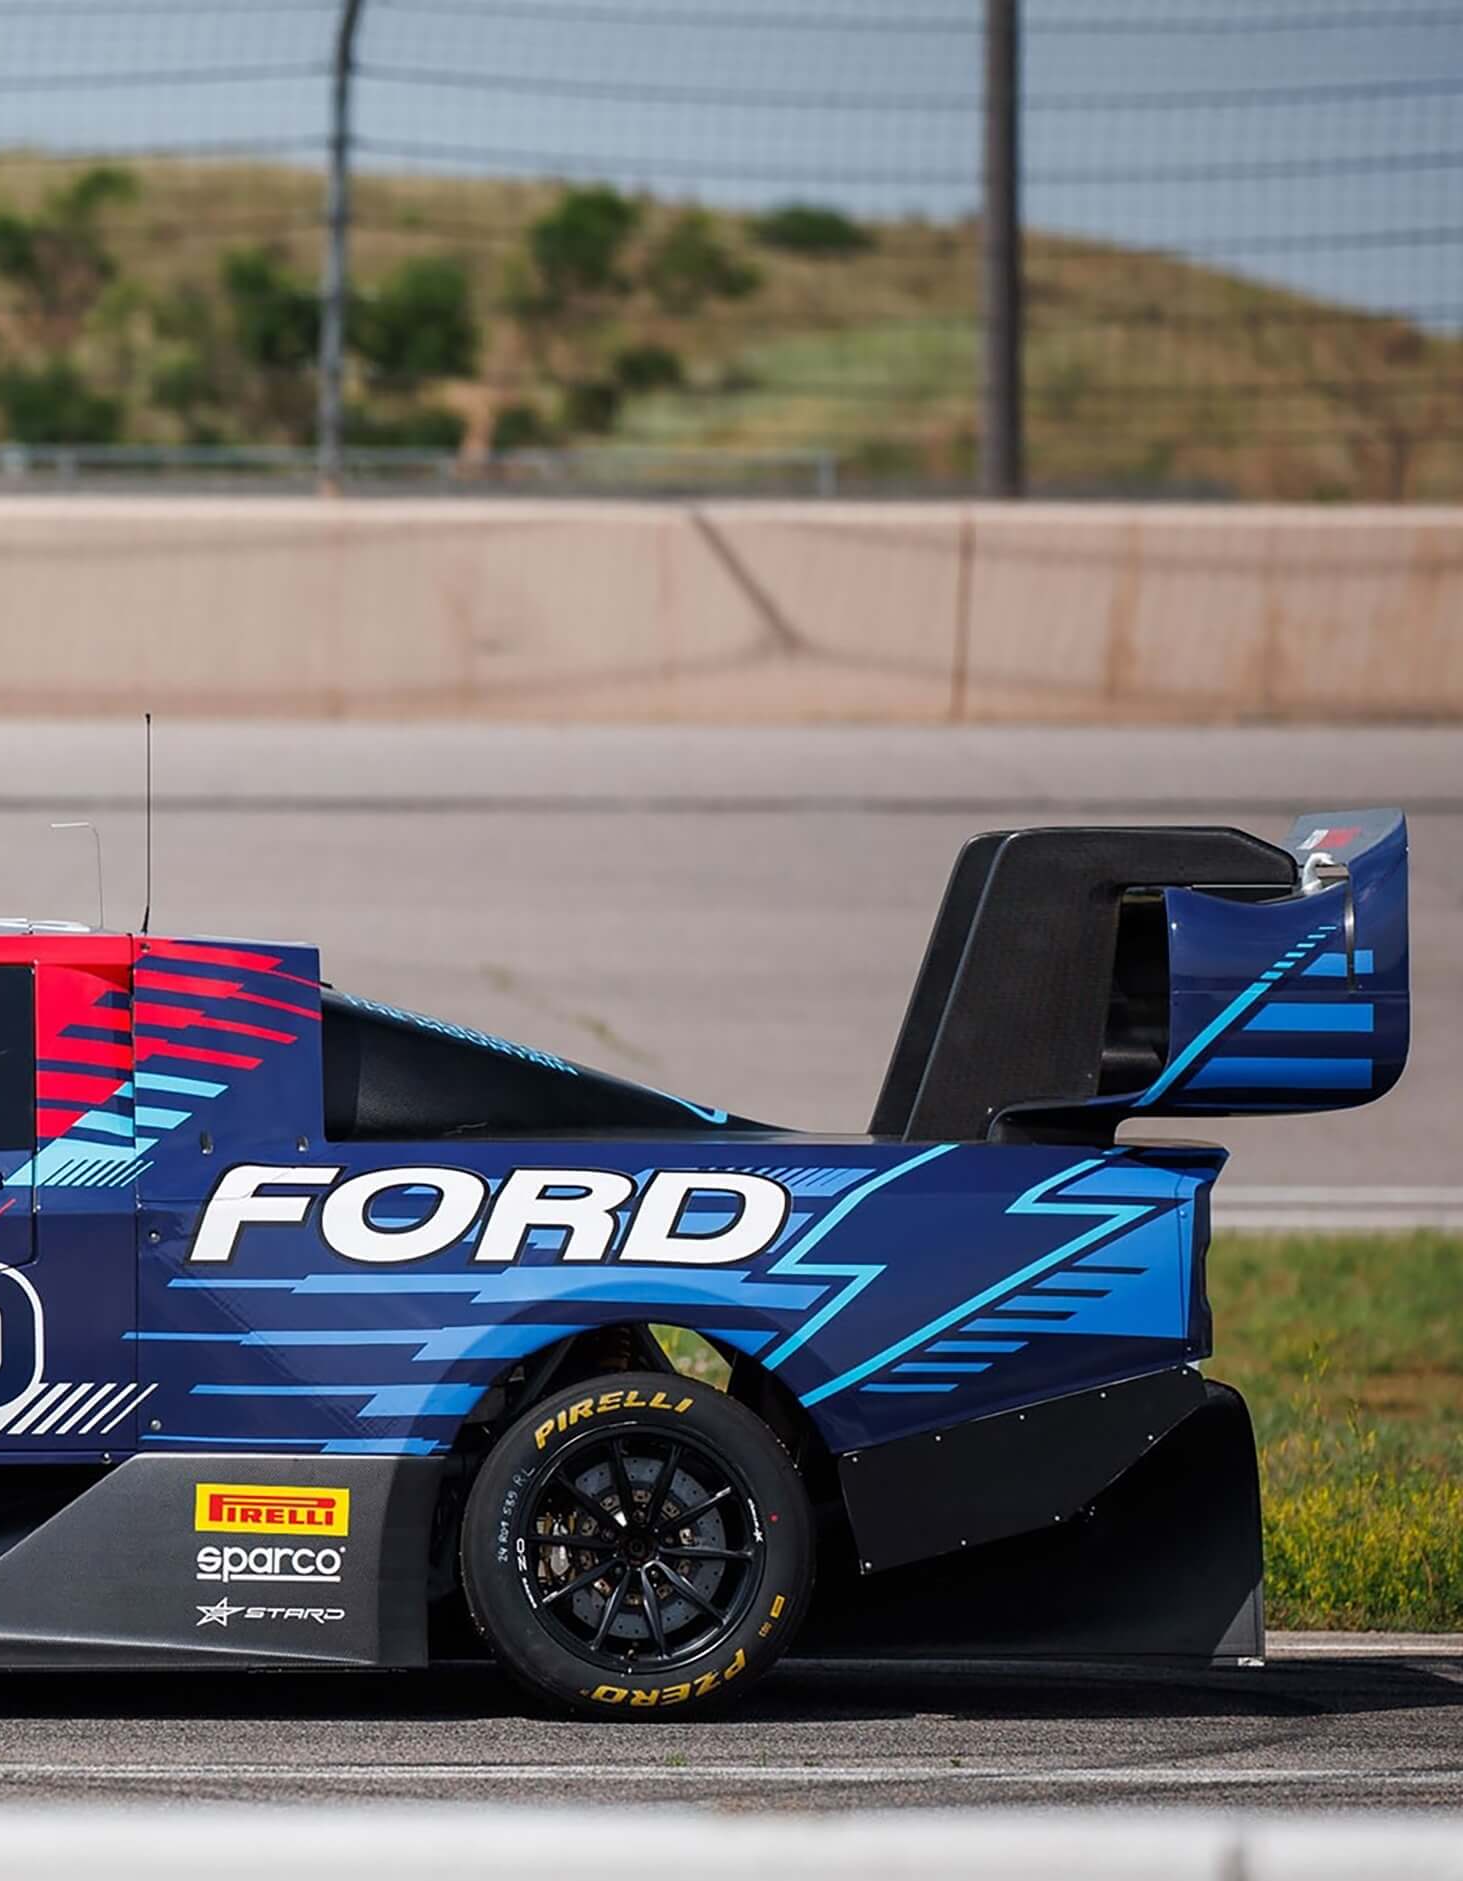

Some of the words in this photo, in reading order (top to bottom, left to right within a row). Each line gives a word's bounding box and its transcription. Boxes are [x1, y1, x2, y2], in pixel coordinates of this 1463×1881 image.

[188, 1165, 786, 1266] FORD
[534, 1391, 694, 1449] PIRELLI
[209, 1494, 336, 1526] PIRELLI
[196, 1546, 342, 1583] sparco
[244, 1607, 345, 1624] STARD
